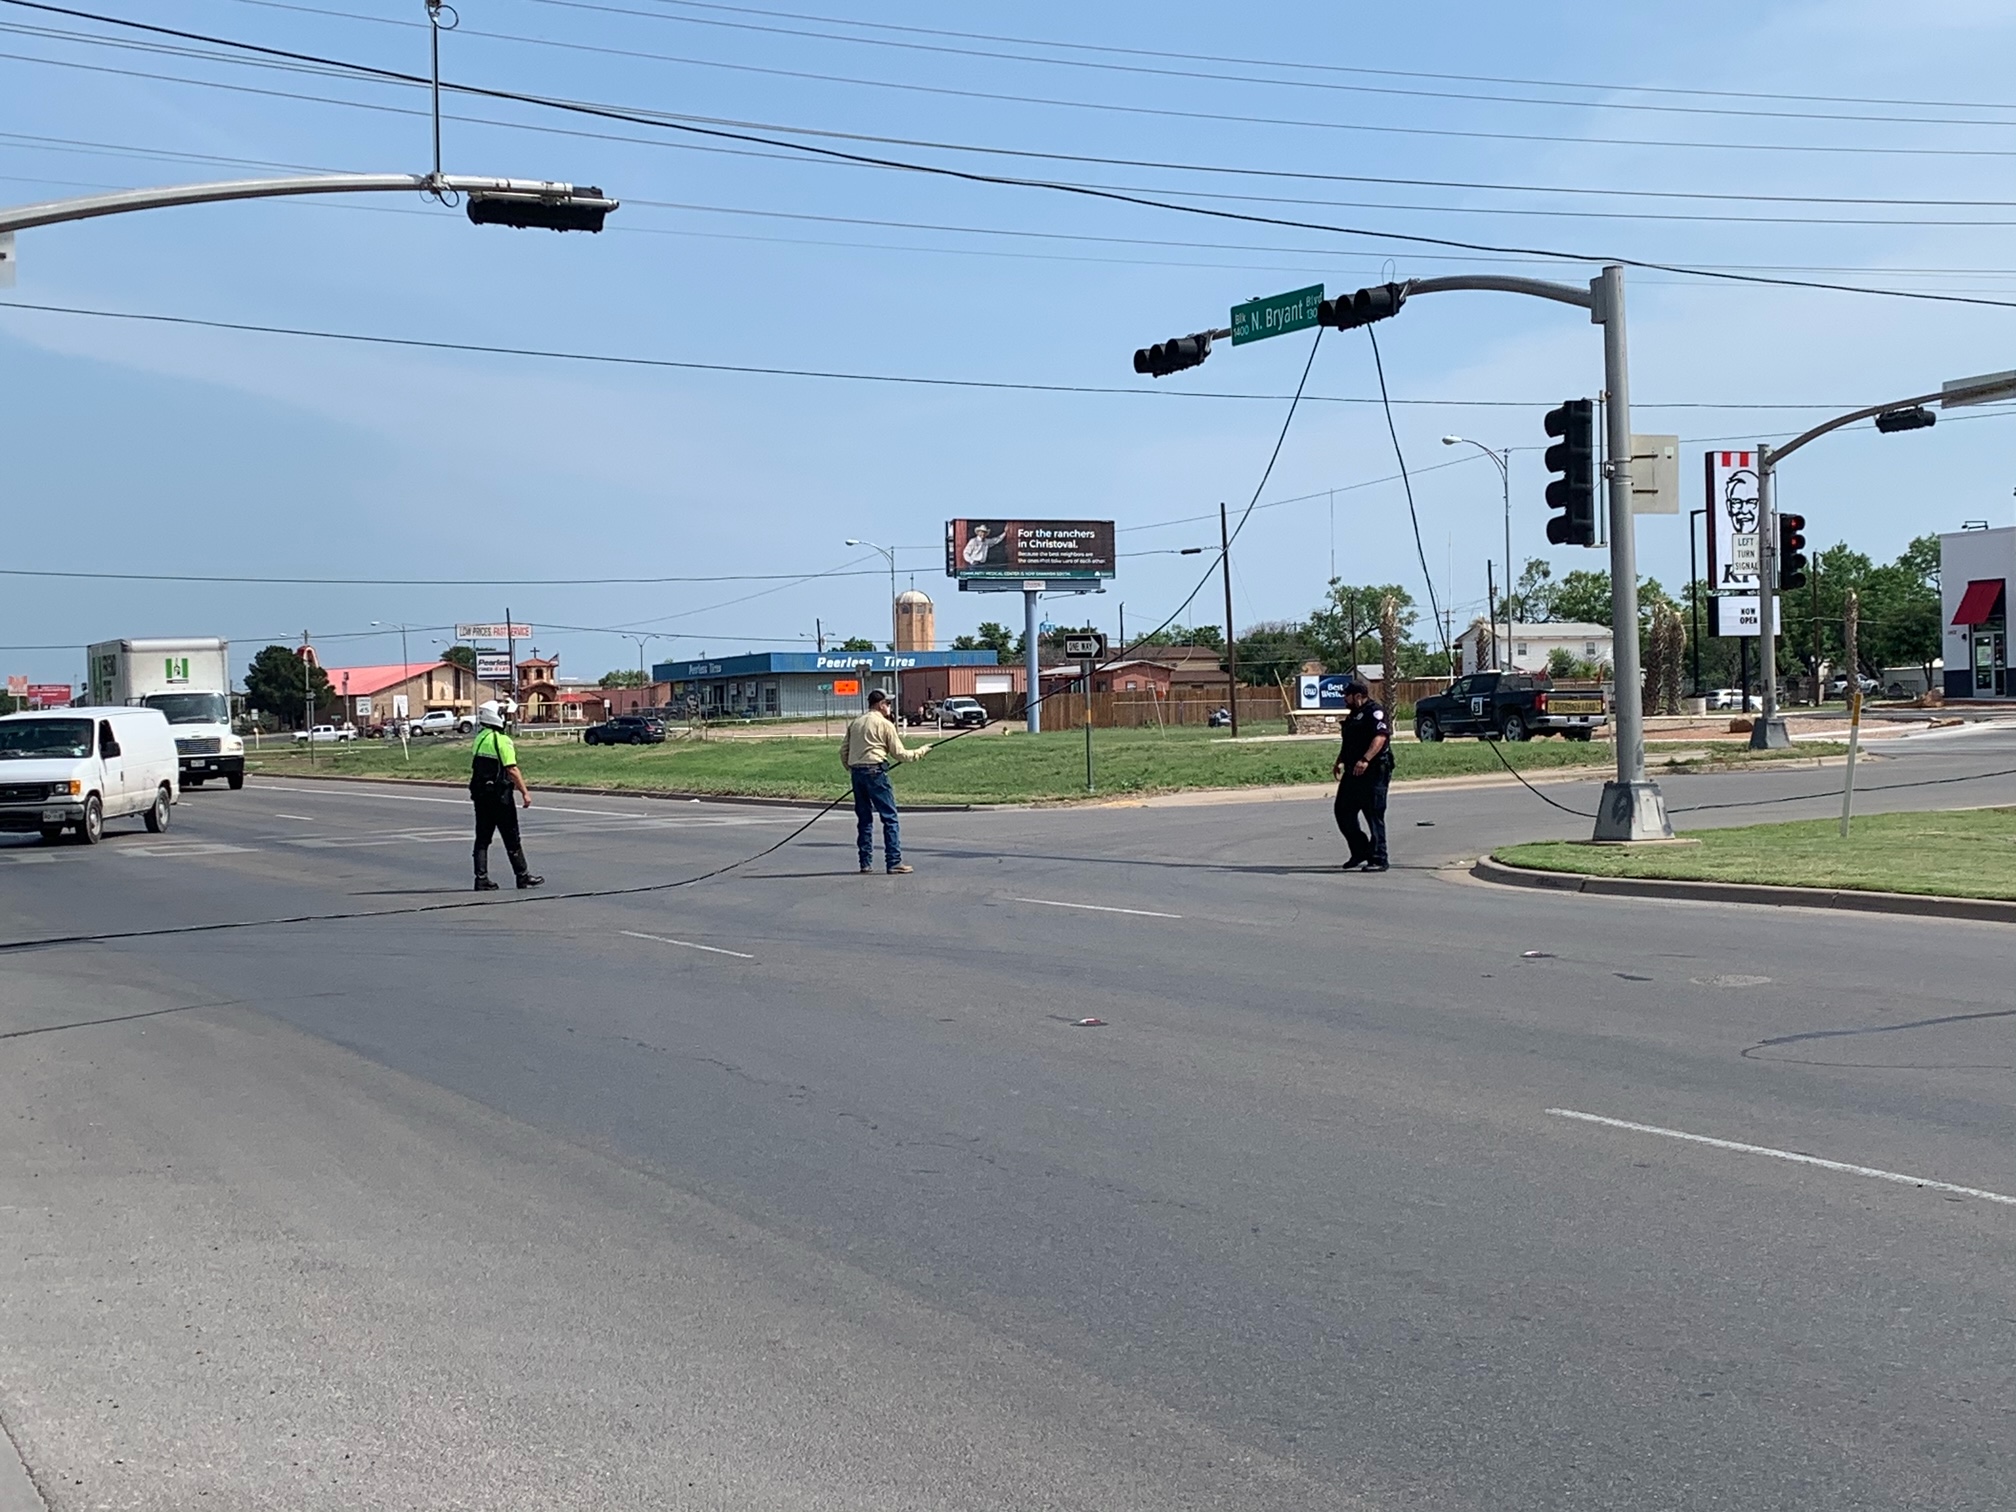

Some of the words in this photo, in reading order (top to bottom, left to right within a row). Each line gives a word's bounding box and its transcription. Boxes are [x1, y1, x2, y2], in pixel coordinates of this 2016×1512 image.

[1252, 311, 1262, 331] N.
[1266, 300, 1302, 330] Bryant
[1306, 292, 1322, 306] Blvd
[1235, 313, 1246, 325] Blk
[1234, 324, 1250, 337] 1400
[1018, 528, 1034, 538] For
[1036, 528, 1052, 538] the
[1054, 529, 1096, 538] ranchers
[1018, 539, 1027, 548] in
[1029, 539, 1078, 548] Christoval.
[1738, 538, 1754, 546] LEFT
[1738, 550, 1754, 558] TURN
[1735, 562, 1758, 570] SIGNAL
[1740, 616, 1758, 624] OPEN
[459, 626, 471, 636] LOW
[510, 627, 529, 636] ERVICE
[1069, 642, 1079, 651] ONE
[816, 656, 874, 668] Peerless
[884, 656, 916, 668] Tires
